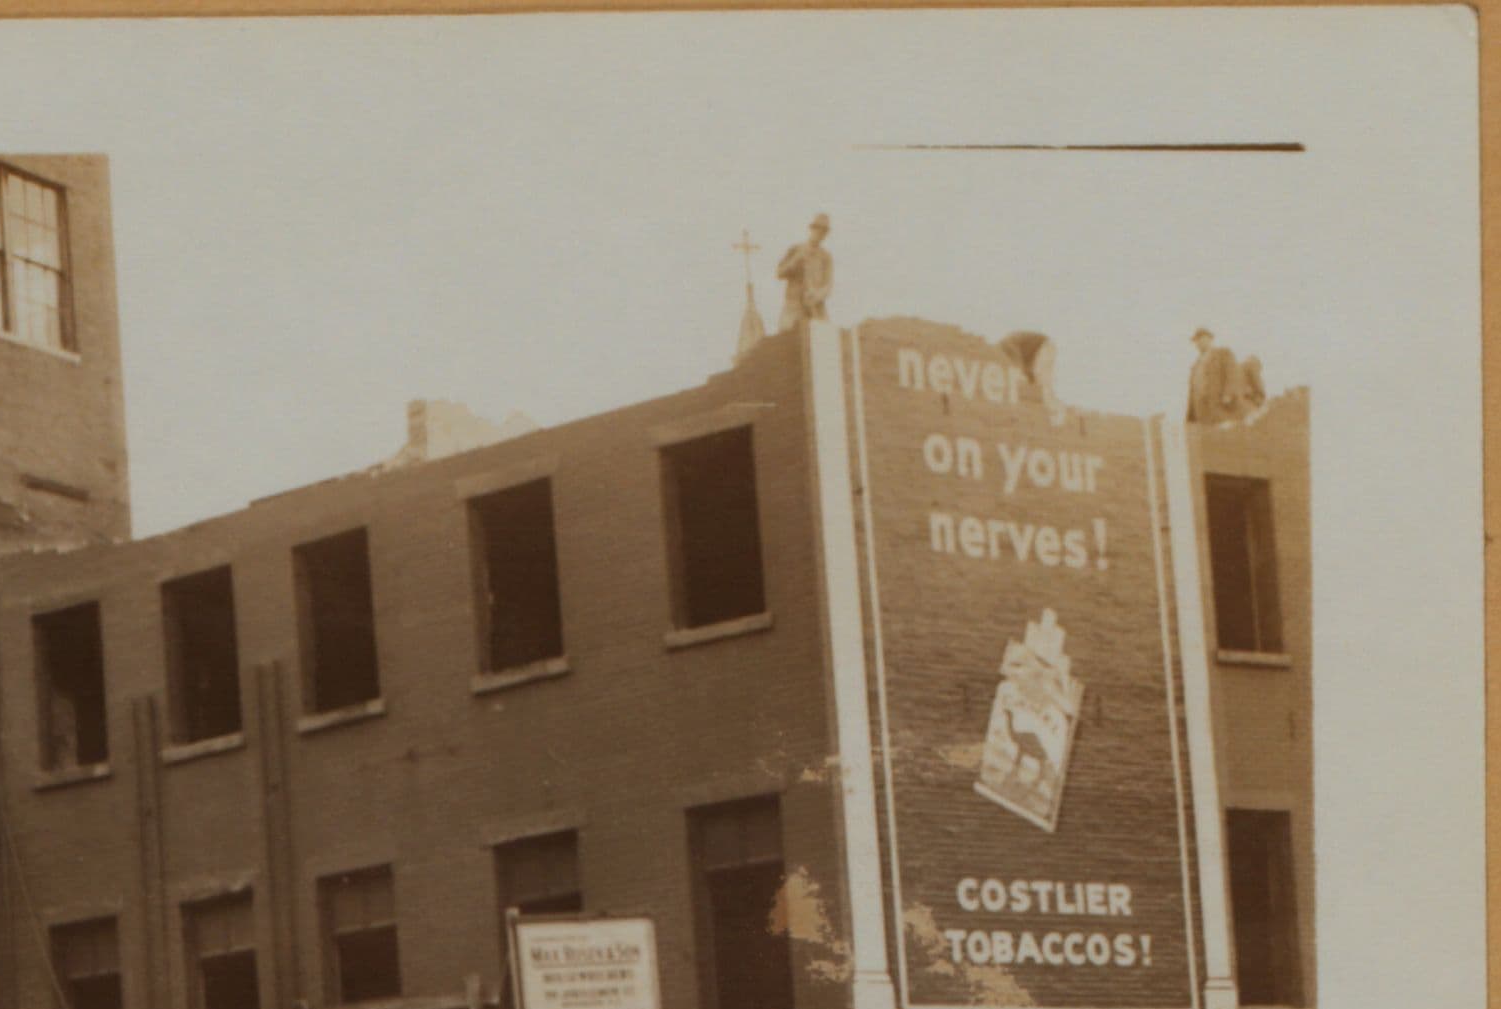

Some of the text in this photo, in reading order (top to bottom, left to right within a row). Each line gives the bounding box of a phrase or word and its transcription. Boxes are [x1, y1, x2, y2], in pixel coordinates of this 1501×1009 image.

[923, 433, 1105, 494] on your
[929, 512, 1109, 571] nerves!
[956, 878, 1133, 916] COSTLIER
[945, 929, 1153, 966] TOBACCOS!
